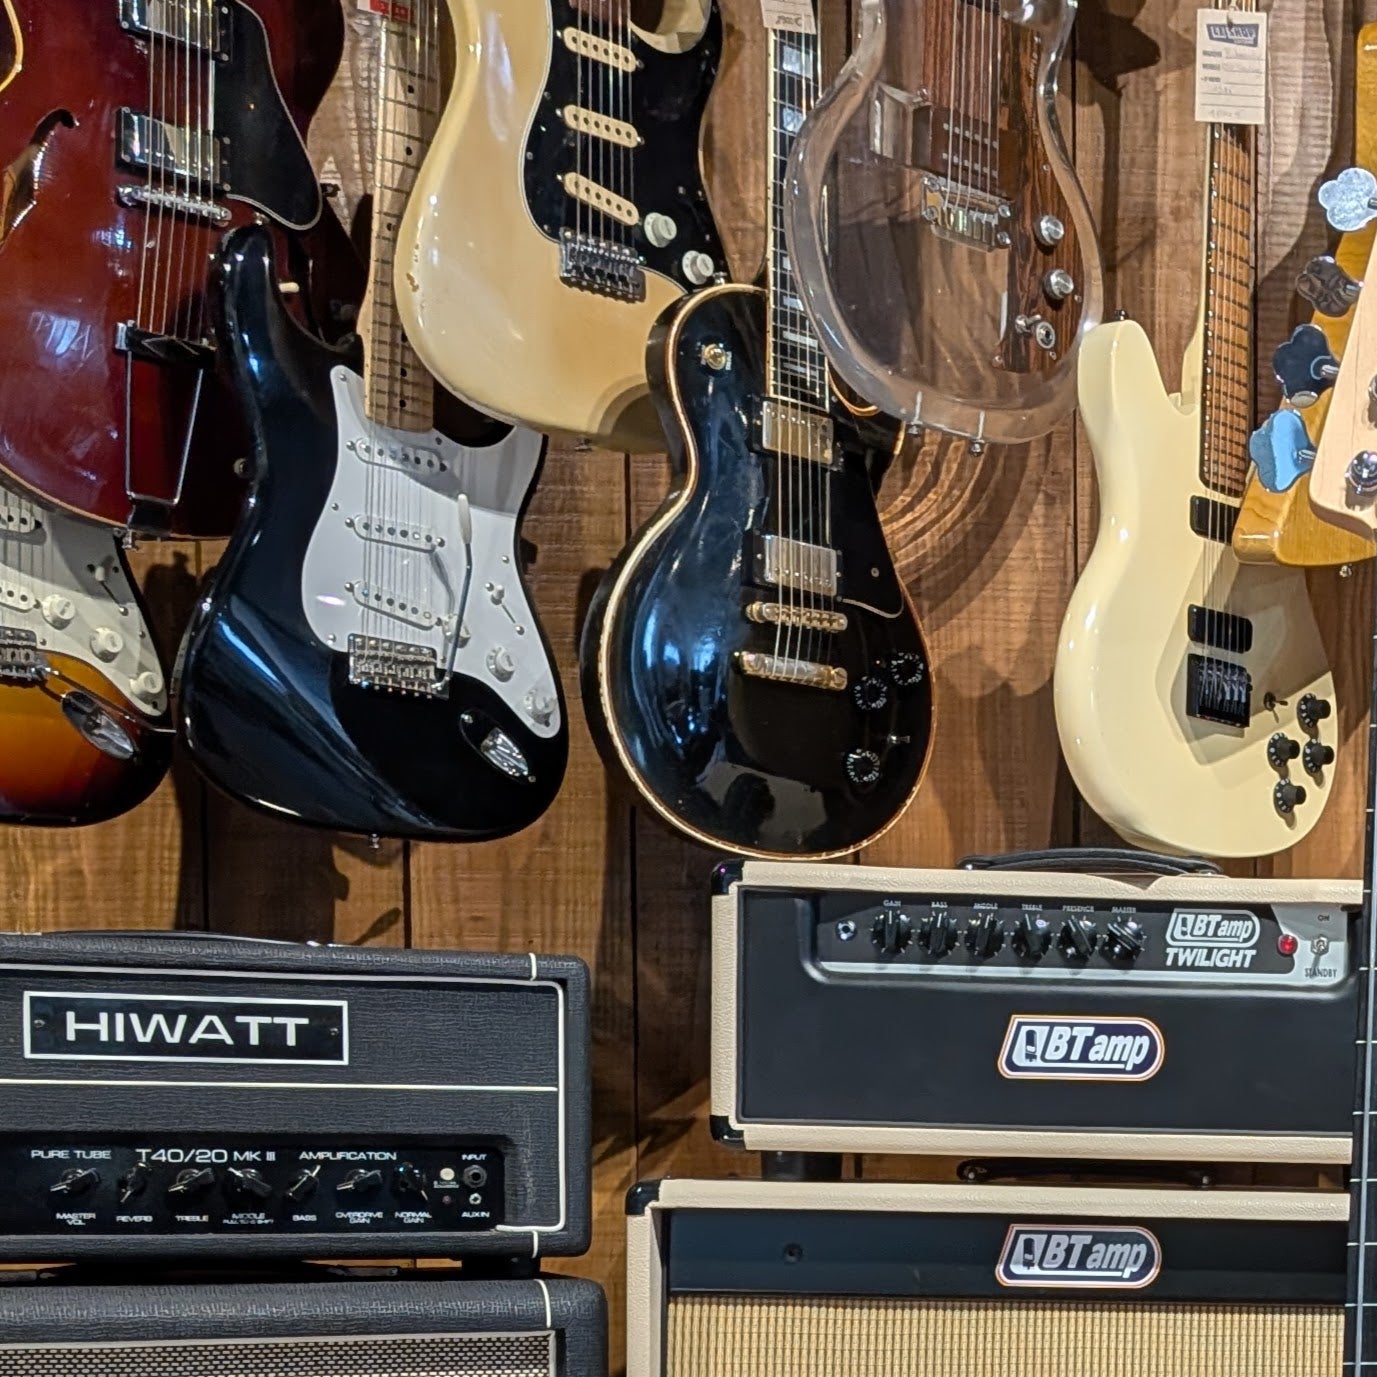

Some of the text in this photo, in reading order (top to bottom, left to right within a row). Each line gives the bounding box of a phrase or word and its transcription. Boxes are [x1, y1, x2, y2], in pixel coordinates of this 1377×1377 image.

[1193, 914, 1253, 943] BT amp
[1165, 948, 1257, 968] TWILIGHT
[1304, 968, 1338, 978] STANDBY
[65, 1010, 310, 1047] HIWATT
[1044, 1026, 1150, 1071] BT amp
[31, 1150, 112, 1160] PURE TUBE
[135, 1149, 229, 1163] T40/20
[233, 1152, 260, 1161] MK
[299, 1151, 397, 1161] AMPLIFICATION
[116, 1215, 153, 1223] REVERB
[1042, 1234, 1147, 1279] BT amp
